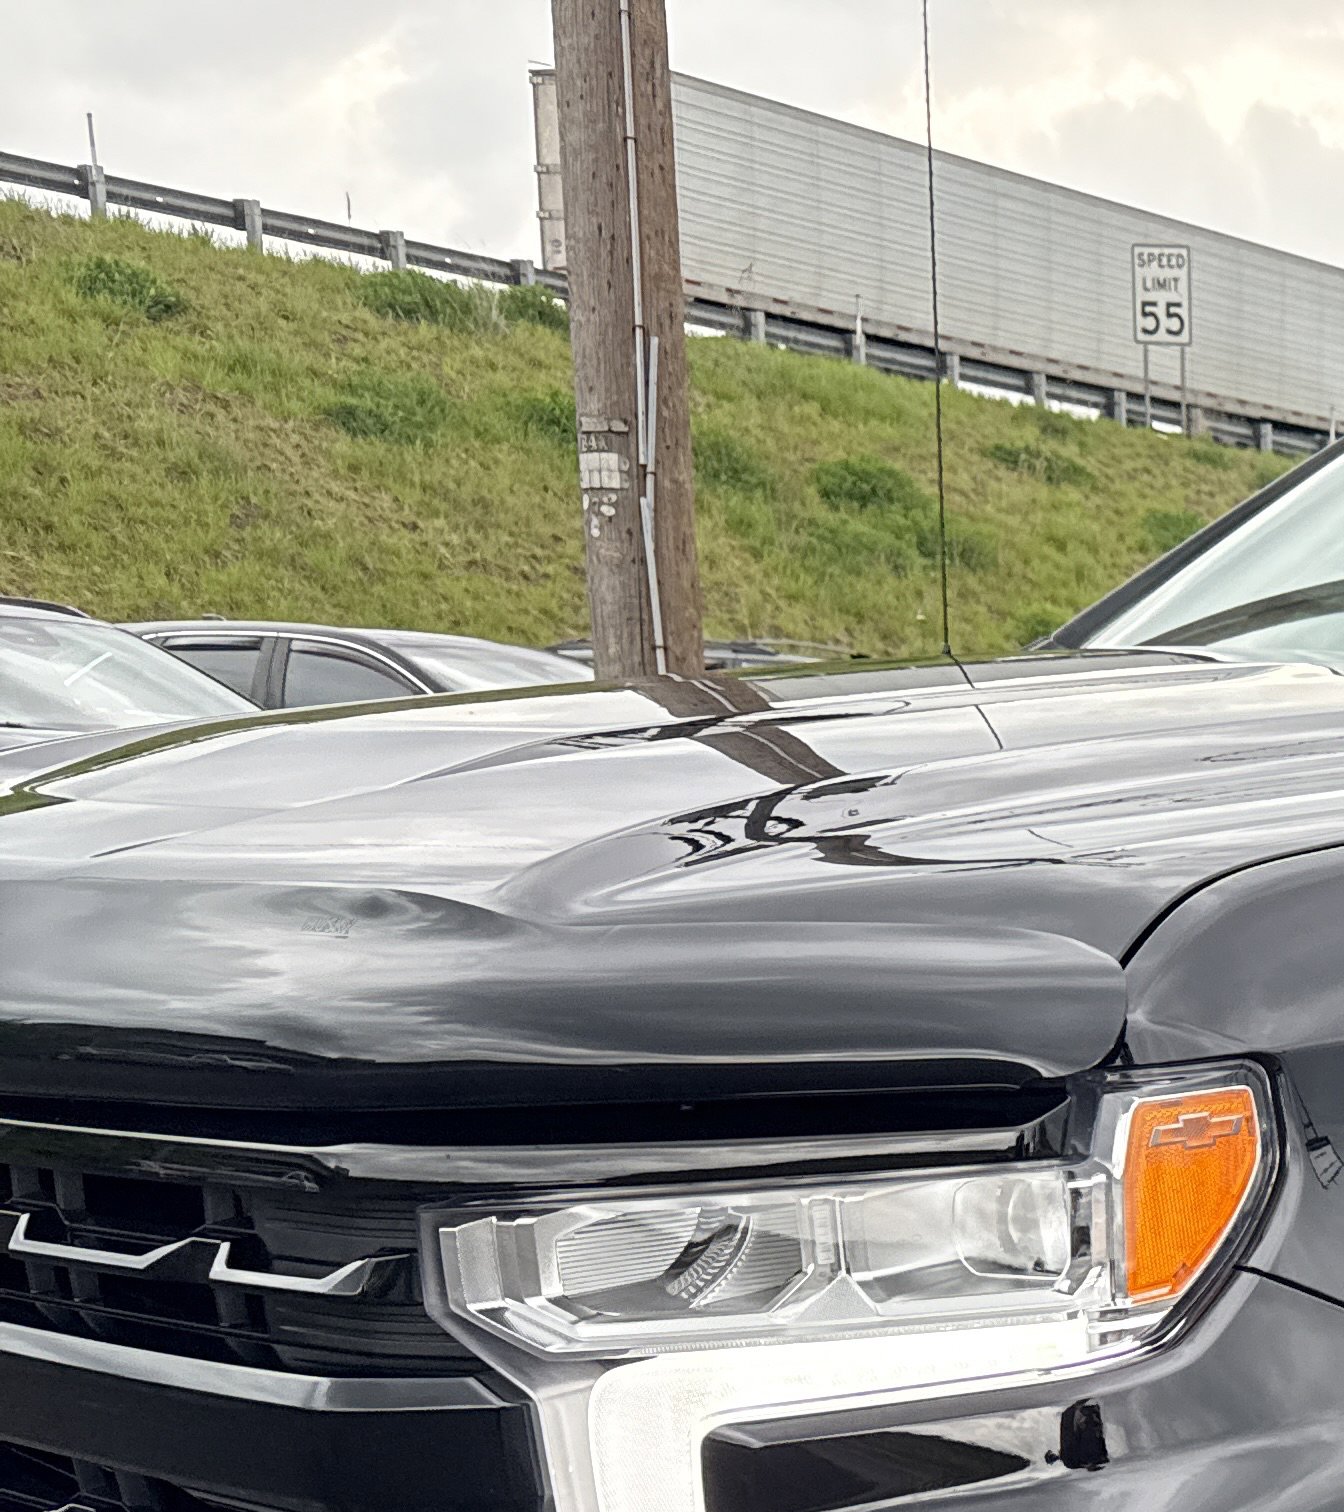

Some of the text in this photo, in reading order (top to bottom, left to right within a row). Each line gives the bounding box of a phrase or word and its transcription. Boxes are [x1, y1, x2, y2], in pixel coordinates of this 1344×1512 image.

[1136, 252, 1185, 269] SPEED
[1142, 277, 1180, 293] LIMIT
[1140, 301, 1185, 336] 55
